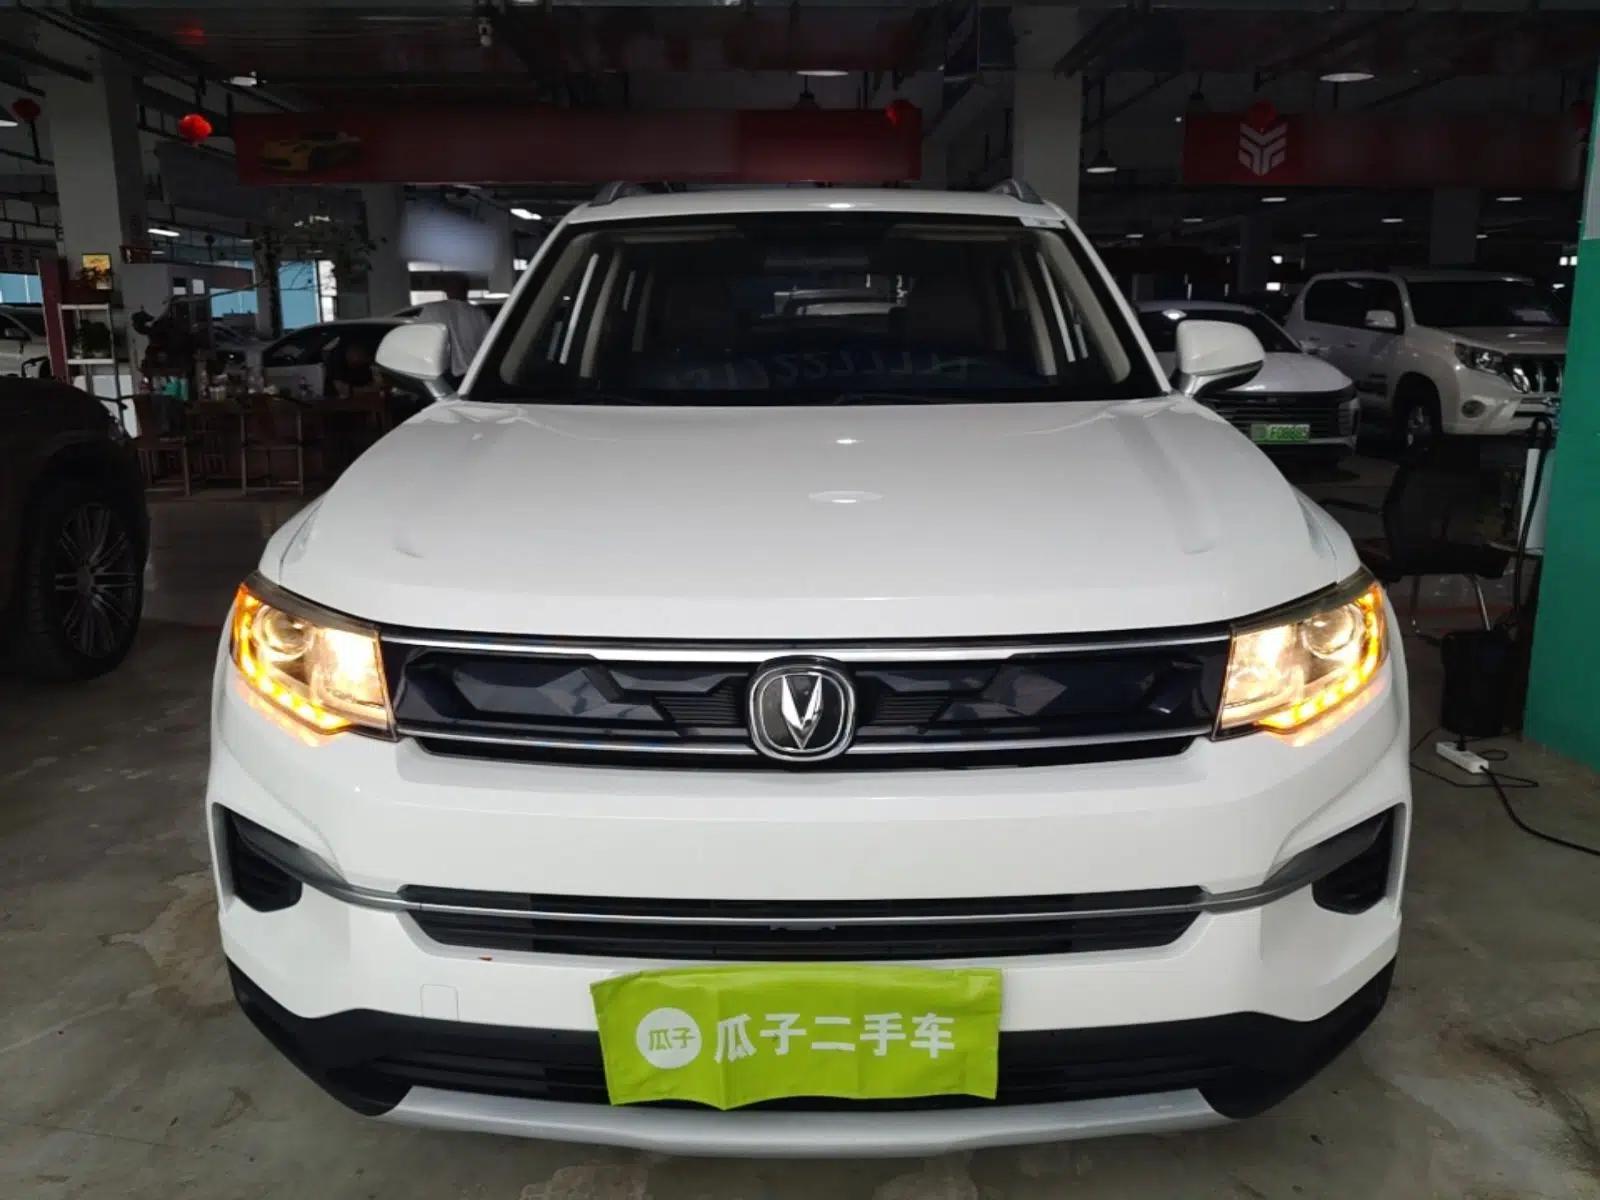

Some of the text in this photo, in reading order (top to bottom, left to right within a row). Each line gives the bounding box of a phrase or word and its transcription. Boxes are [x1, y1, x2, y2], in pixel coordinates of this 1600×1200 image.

[648, 1026, 696, 1051] 瓜子
[714, 1012, 956, 1064] 瓜子二手车
